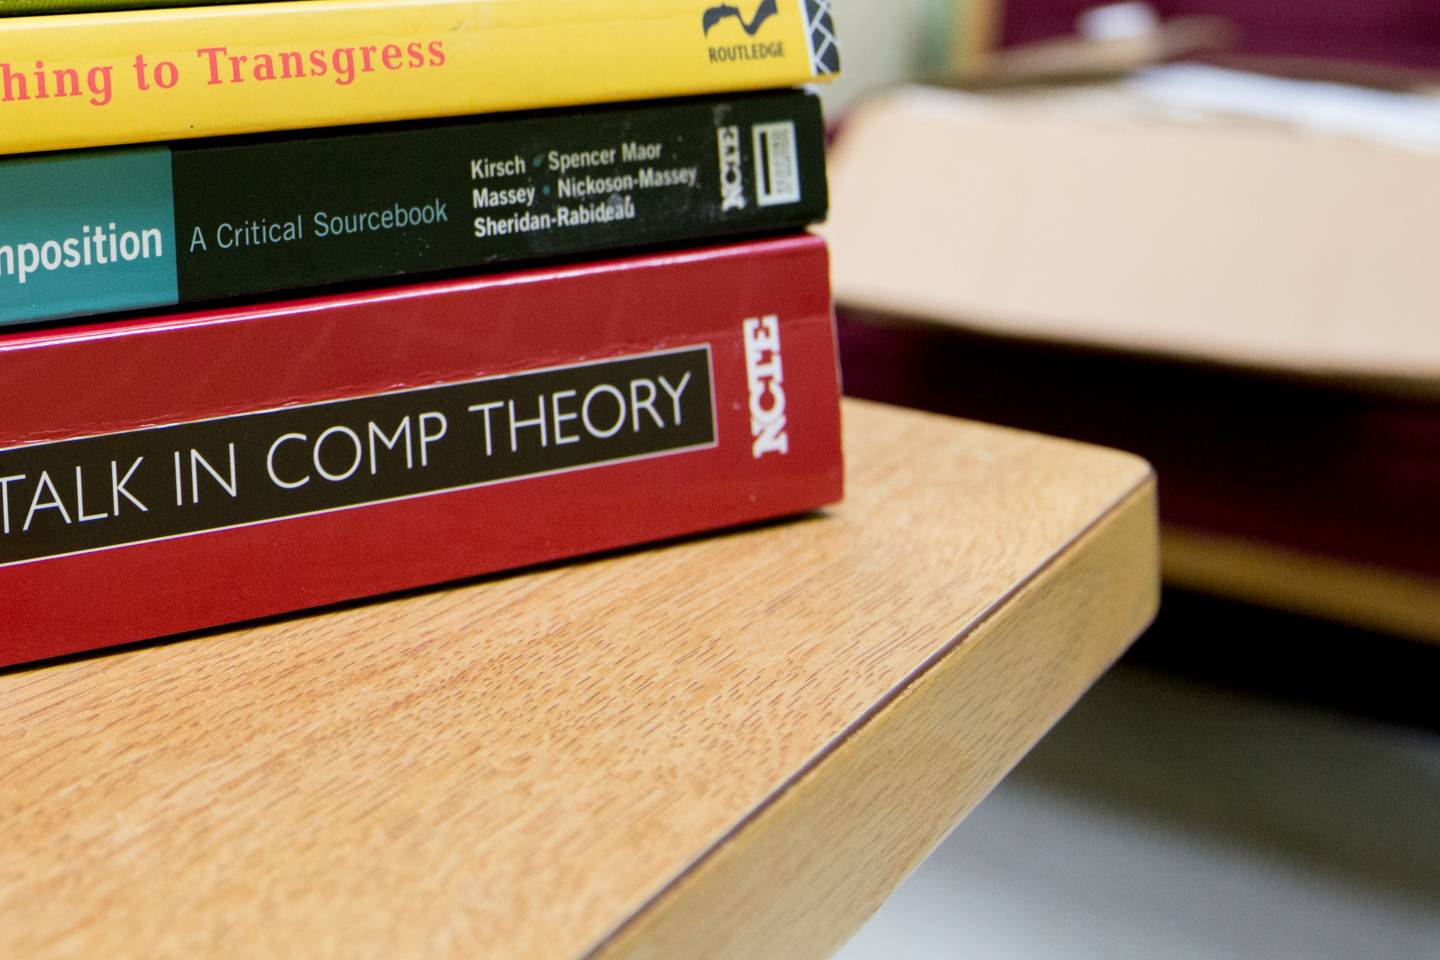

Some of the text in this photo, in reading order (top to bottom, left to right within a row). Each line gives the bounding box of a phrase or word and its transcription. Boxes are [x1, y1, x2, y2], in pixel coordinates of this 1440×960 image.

[133, 54, 179, 91] to
[197, 39, 446, 86] Transgress
[709, 42, 784, 62] ROUTLEDGE
[471, 141, 663, 179] Kirsch Spencer Maor
[472, 165, 697, 209] Massey Nickoson-Massey
[189, 199, 448, 252] A Critical Sourcebook
[474, 195, 635, 238] Sheridan-Rabideau
[173, 442, 237, 507] IN
[267, 411, 448, 492] COMP
[468, 371, 692, 457] THEORY
